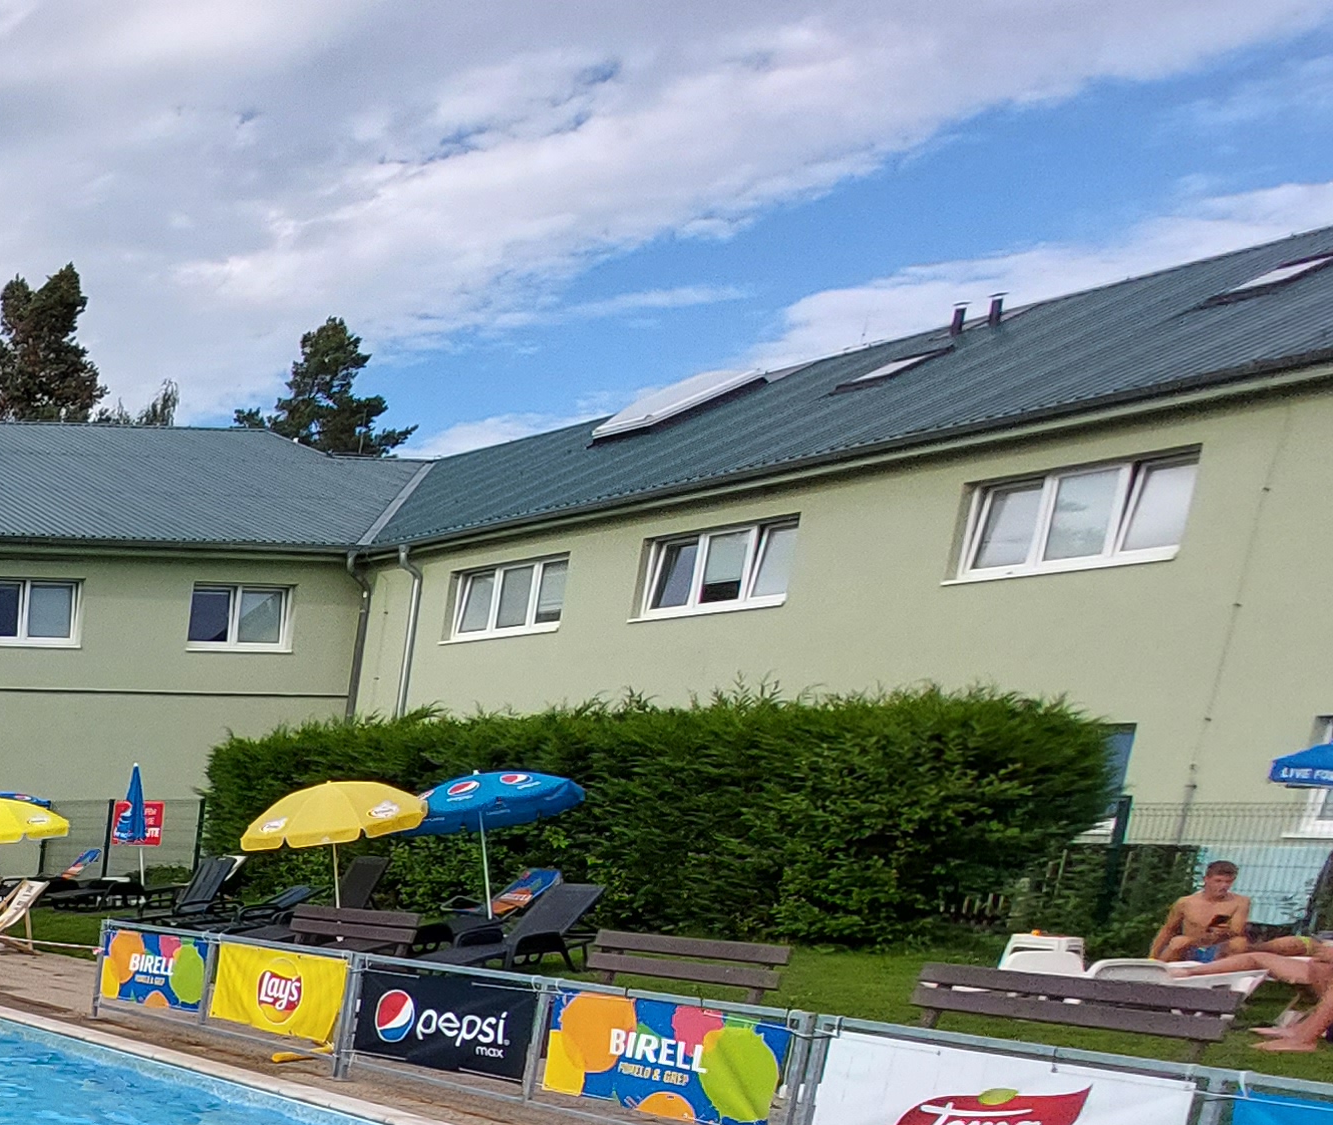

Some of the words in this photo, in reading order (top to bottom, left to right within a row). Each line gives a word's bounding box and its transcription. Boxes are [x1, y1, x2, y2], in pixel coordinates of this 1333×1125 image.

[129, 953, 174, 976] BIRELL
[259, 971, 302, 1011] Lay's
[416, 1009, 509, 1047] pepsi
[475, 1045, 505, 1059] max
[609, 1028, 708, 1074] BIRELL
